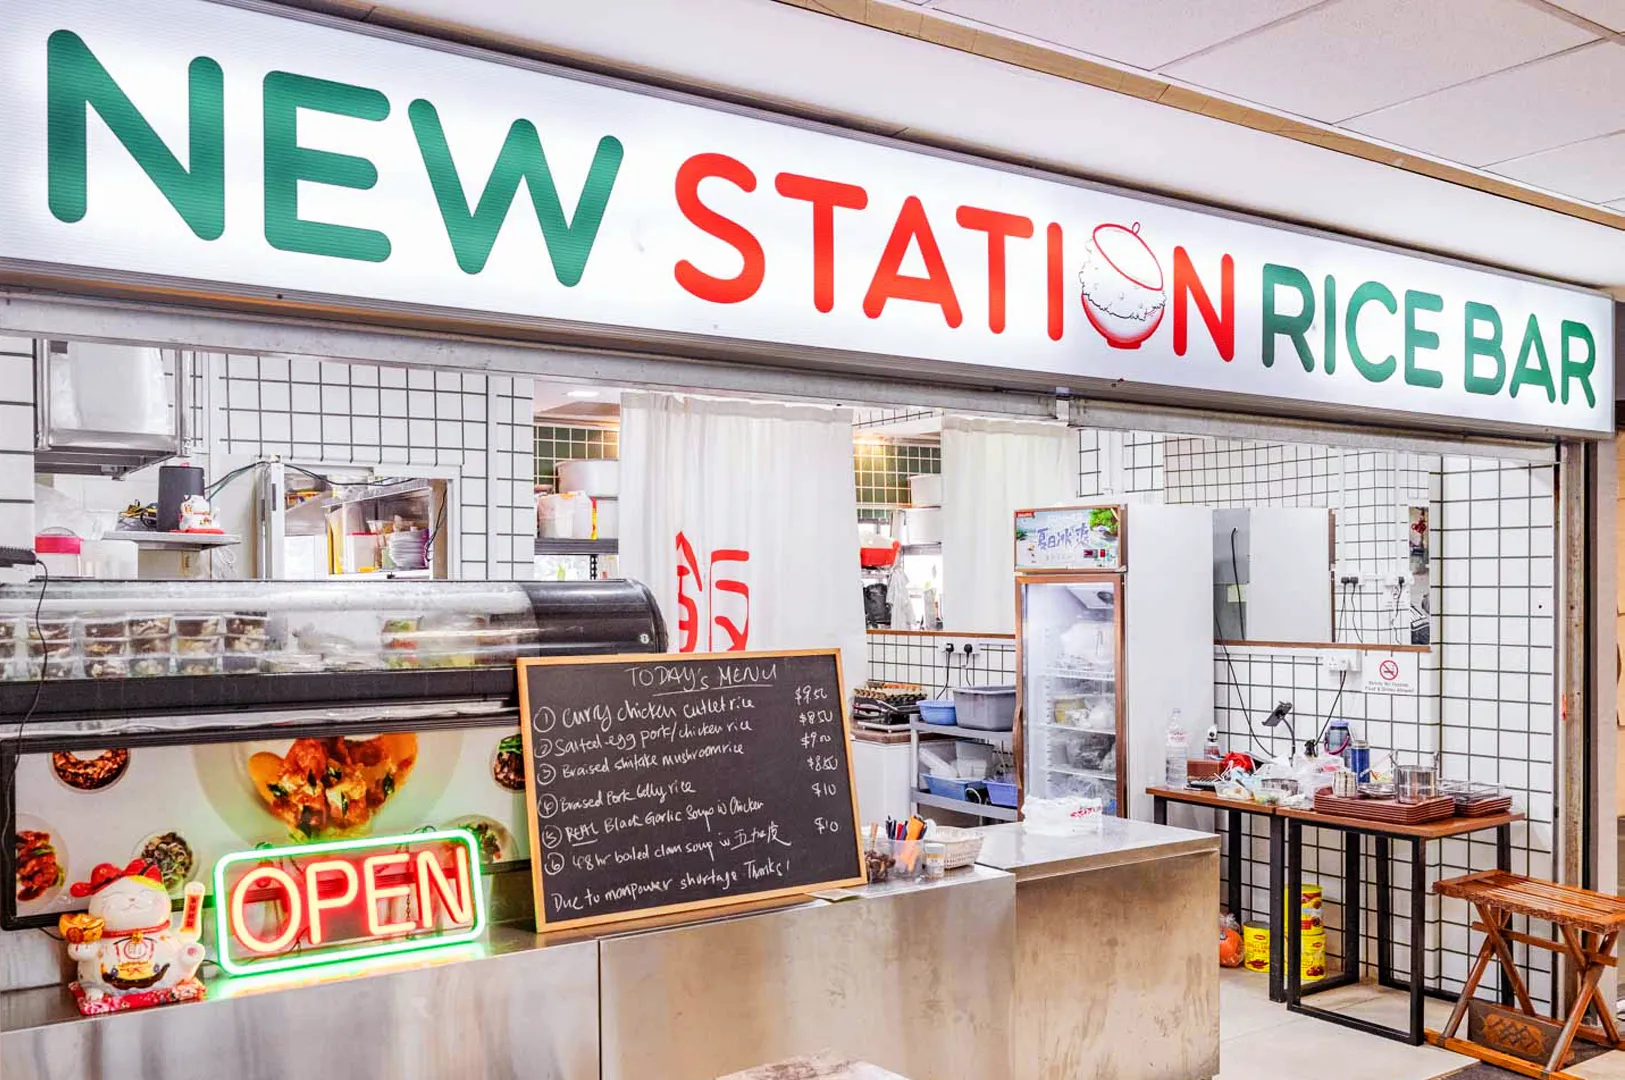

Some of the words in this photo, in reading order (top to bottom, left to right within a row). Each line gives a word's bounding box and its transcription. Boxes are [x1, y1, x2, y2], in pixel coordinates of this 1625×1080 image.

[47, 29, 625, 287] NEW
[1262, 263, 1443, 388] RICE
[1463, 300, 1597, 409] BAR
[718, 663, 778, 687] MENU
[617, 699, 677, 722] chicken
[554, 736, 604, 757] Salted
[727, 718, 753, 732] rice
[562, 757, 611, 779] Braised
[669, 779, 697, 795] rice
[811, 783, 837, 797] $10
[603, 815, 643, 834] Black
[644, 810, 682, 827] Garlic
[814, 817, 839, 834] $10
[654, 842, 683, 859] clam
[686, 840, 714, 861] soup
[231, 845, 476, 953] OPEN
[551, 893, 584, 912] Due
[584, 888, 600, 907] to
[605, 878, 674, 901] manpower
[680, 868, 738, 890] shortage
